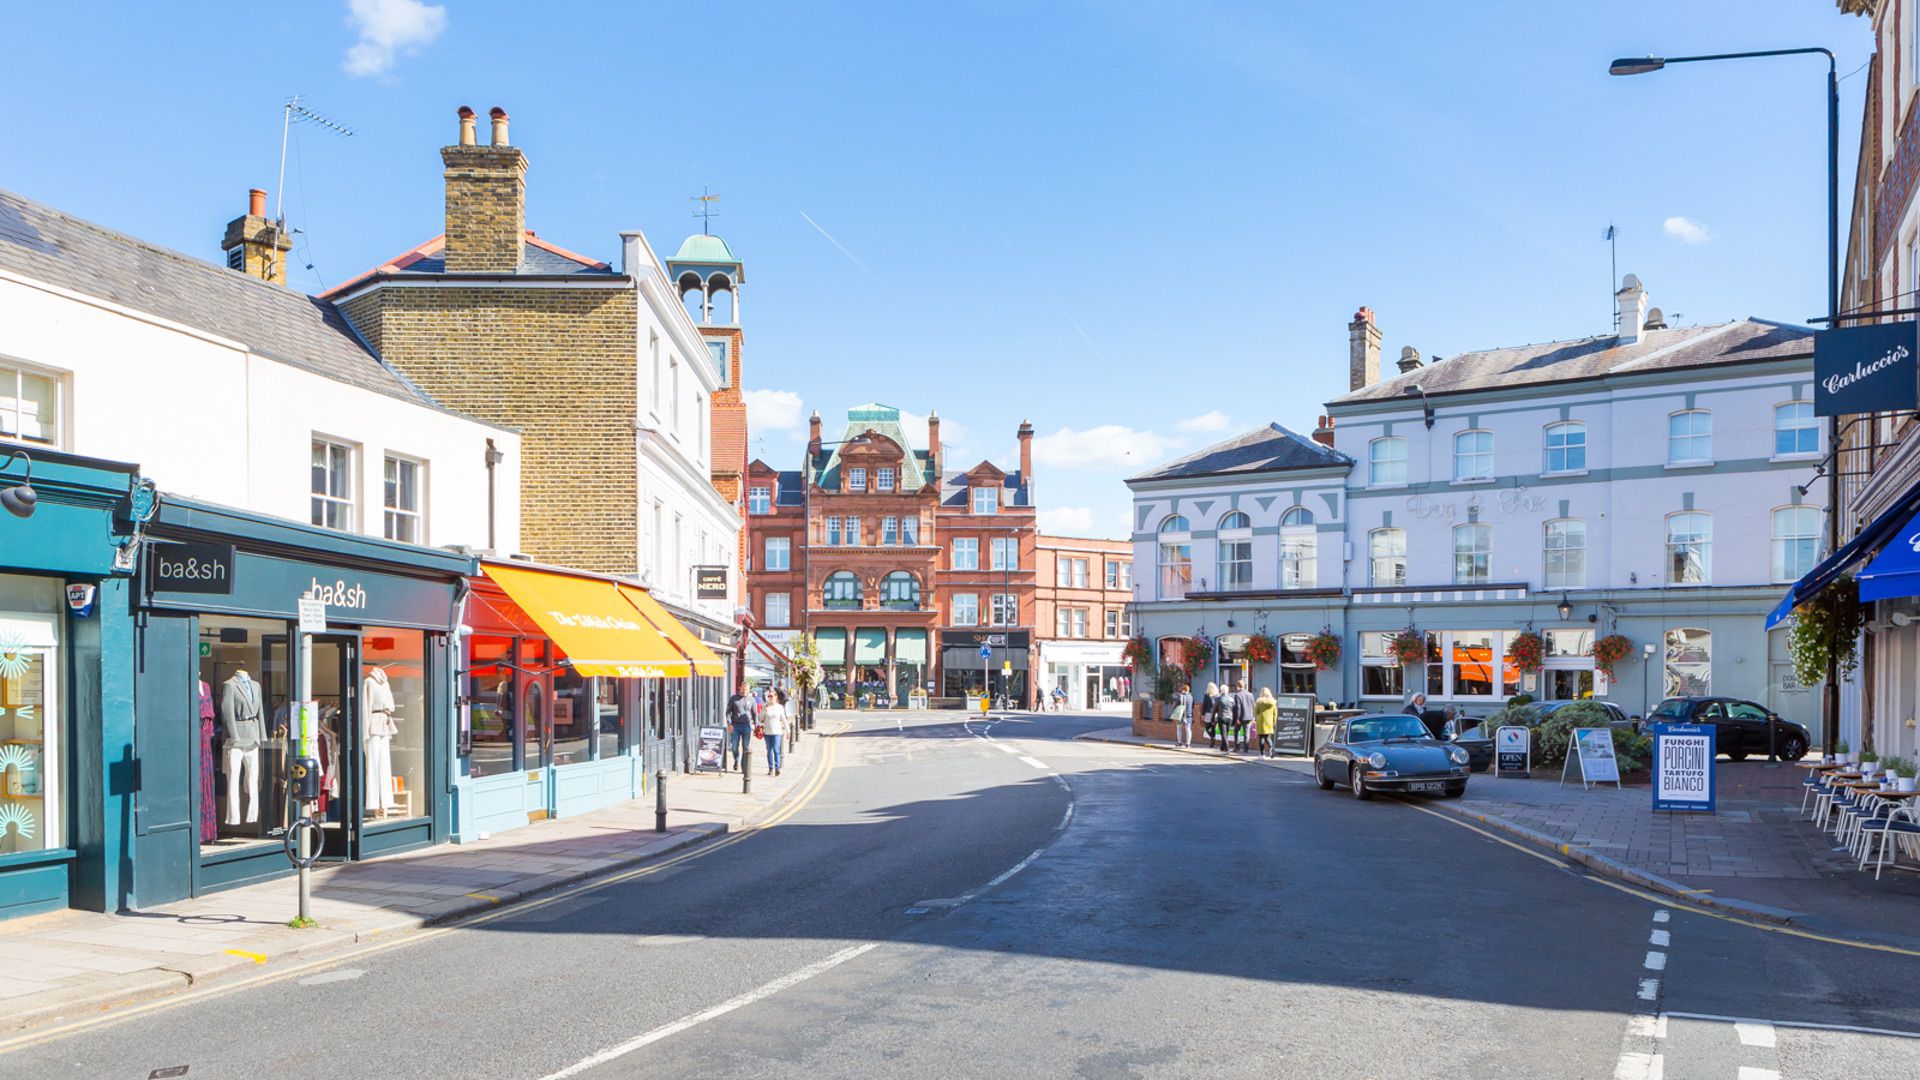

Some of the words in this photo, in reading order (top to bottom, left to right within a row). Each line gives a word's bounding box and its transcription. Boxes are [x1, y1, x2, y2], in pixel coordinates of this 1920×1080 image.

[1823, 345, 1909, 394] Carluccio's
[1406, 493, 1456, 525] Dog
[160, 557, 225, 580] ba&sh
[312, 577, 366, 609] ba&sh
[698, 583, 726, 591] NERO
[70, 591, 85, 600] APT
[547, 611, 576, 627] The
[763, 632, 784, 640] Travel
[1667, 725, 1701, 733] Carluccio's
[1501, 753, 1522, 761] OPEN
[1664, 746, 1704, 770] PORCINI
[1664, 777, 1704, 792] BIANCO
